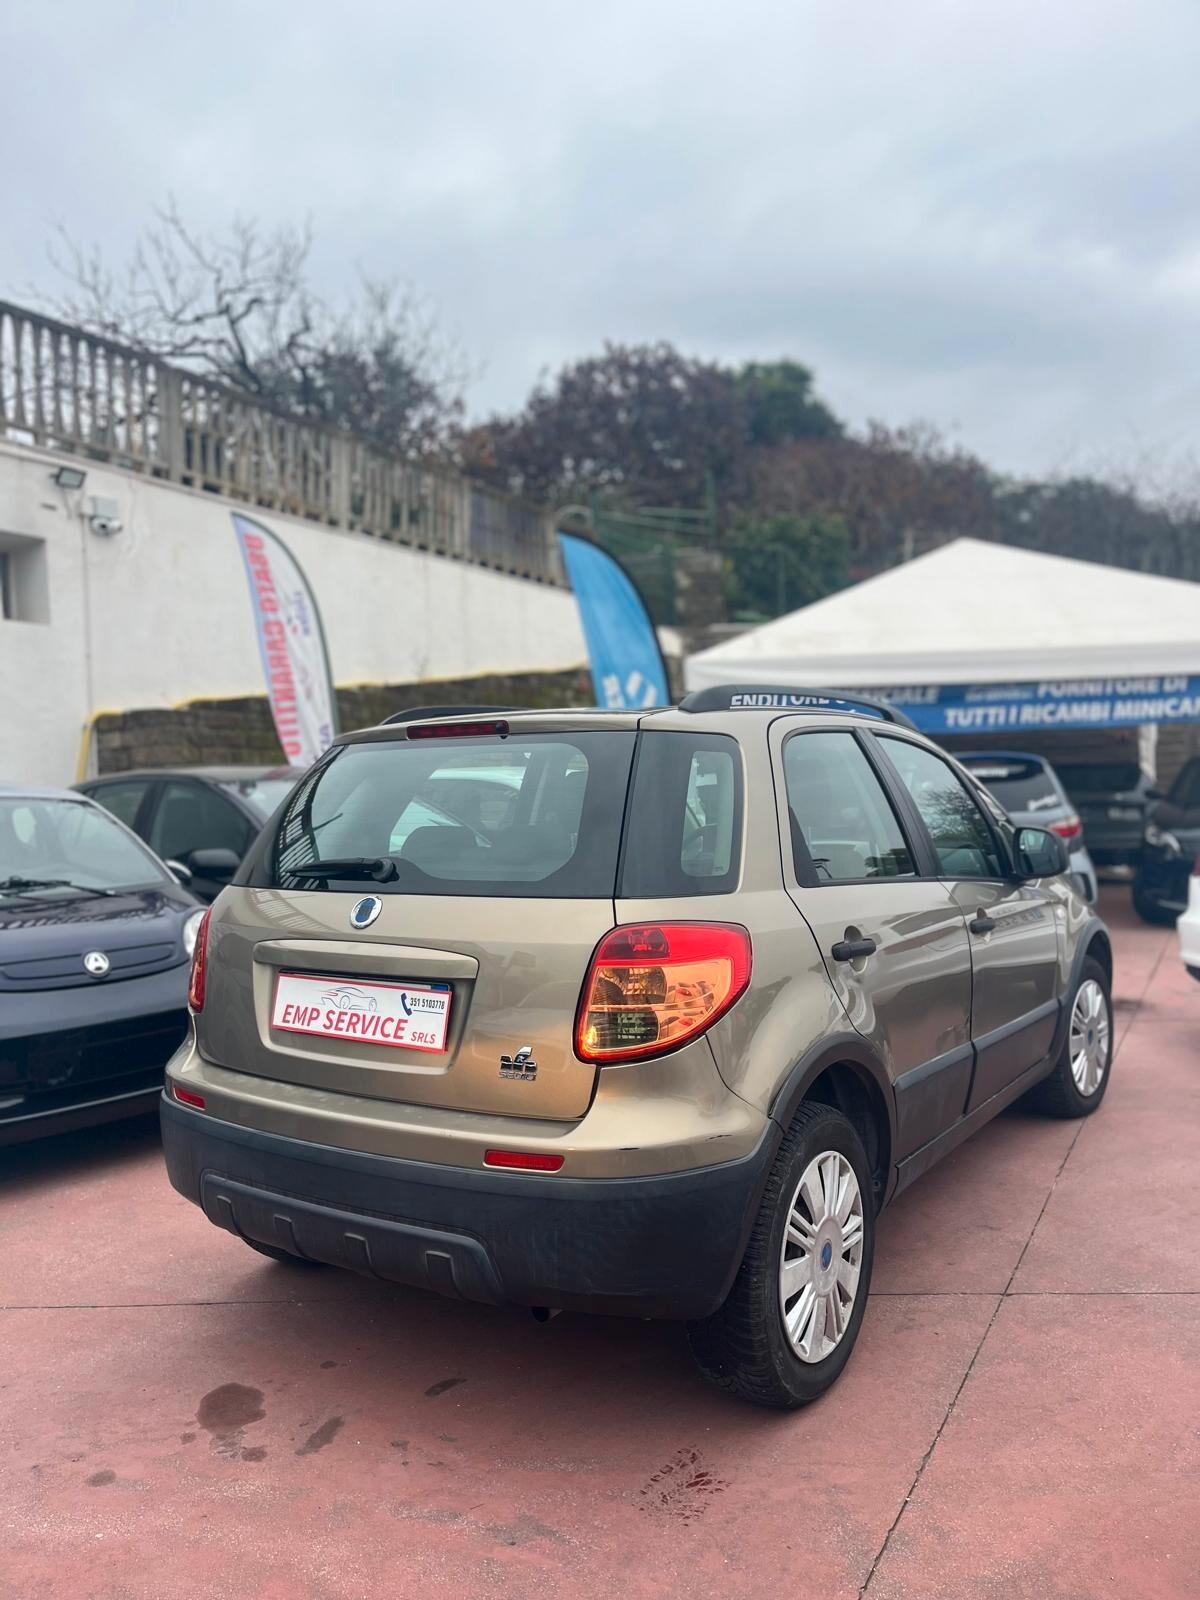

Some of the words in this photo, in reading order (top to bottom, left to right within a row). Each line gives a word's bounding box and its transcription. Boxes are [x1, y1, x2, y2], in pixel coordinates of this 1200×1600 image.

[945, 705, 1005, 727] TUTTI
[1019, 700, 1110, 723] RICAMBI
[410, 997, 421, 1007] 351
[282, 1004, 320, 1027] EMP
[322, 1010, 408, 1040] SERVICE
[410, 1031, 436, 1044] SRLS
